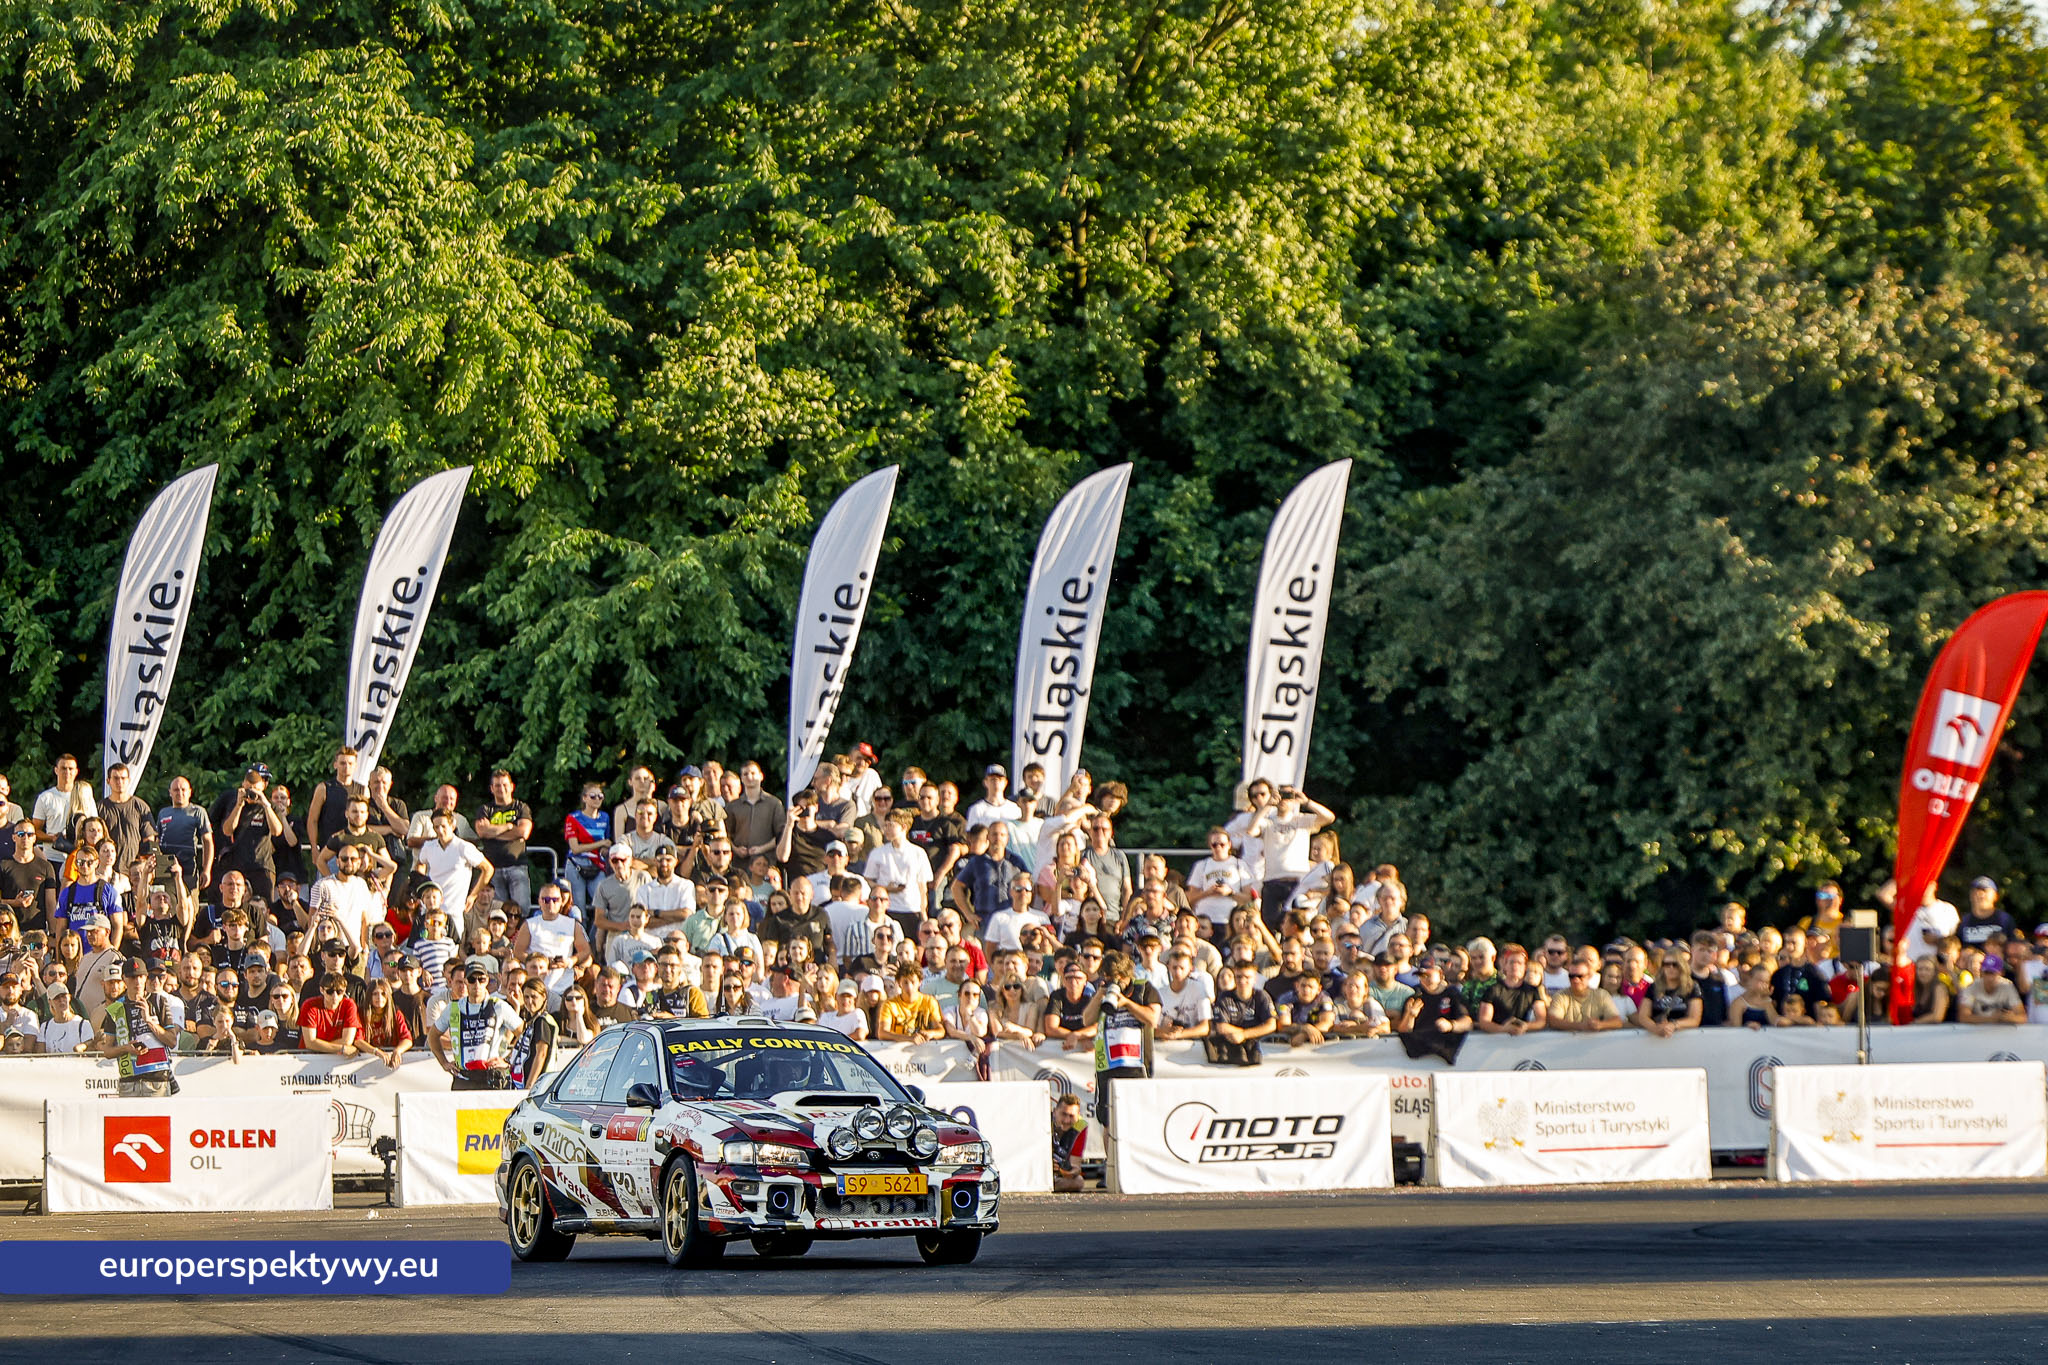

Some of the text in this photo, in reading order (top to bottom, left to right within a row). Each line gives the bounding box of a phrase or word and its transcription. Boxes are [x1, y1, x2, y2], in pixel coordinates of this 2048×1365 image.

[110, 568, 185, 766] Śląskie.
[1023, 564, 1097, 757] Śląskie.
[1252, 562, 1321, 757] Śląskie.
[667, 1036, 868, 1058] RALLY CONTROL
[280, 1072, 357, 1089] STADION ŚLĄSKI
[1534, 1097, 1636, 1116] Ministerstwo
[1873, 1095, 1975, 1112] Ministerstwo
[1206, 1114, 1345, 1141] MOTO
[1535, 1115, 1670, 1138] Sportu i Turystyki
[1874, 1112, 2008, 1134] Sportu i Turystyki
[190, 1129, 277, 1149] ORLEN
[464, 1134, 501, 1152] RM
[190, 1154, 222, 1170] OIL
[1198, 1141, 1338, 1164] WIZJA
[556, 1166, 593, 1206] kratki
[848, 1176, 868, 1193] S9
[884, 1176, 921, 1193] 5621
[852, 1217, 937, 1229] kratki
